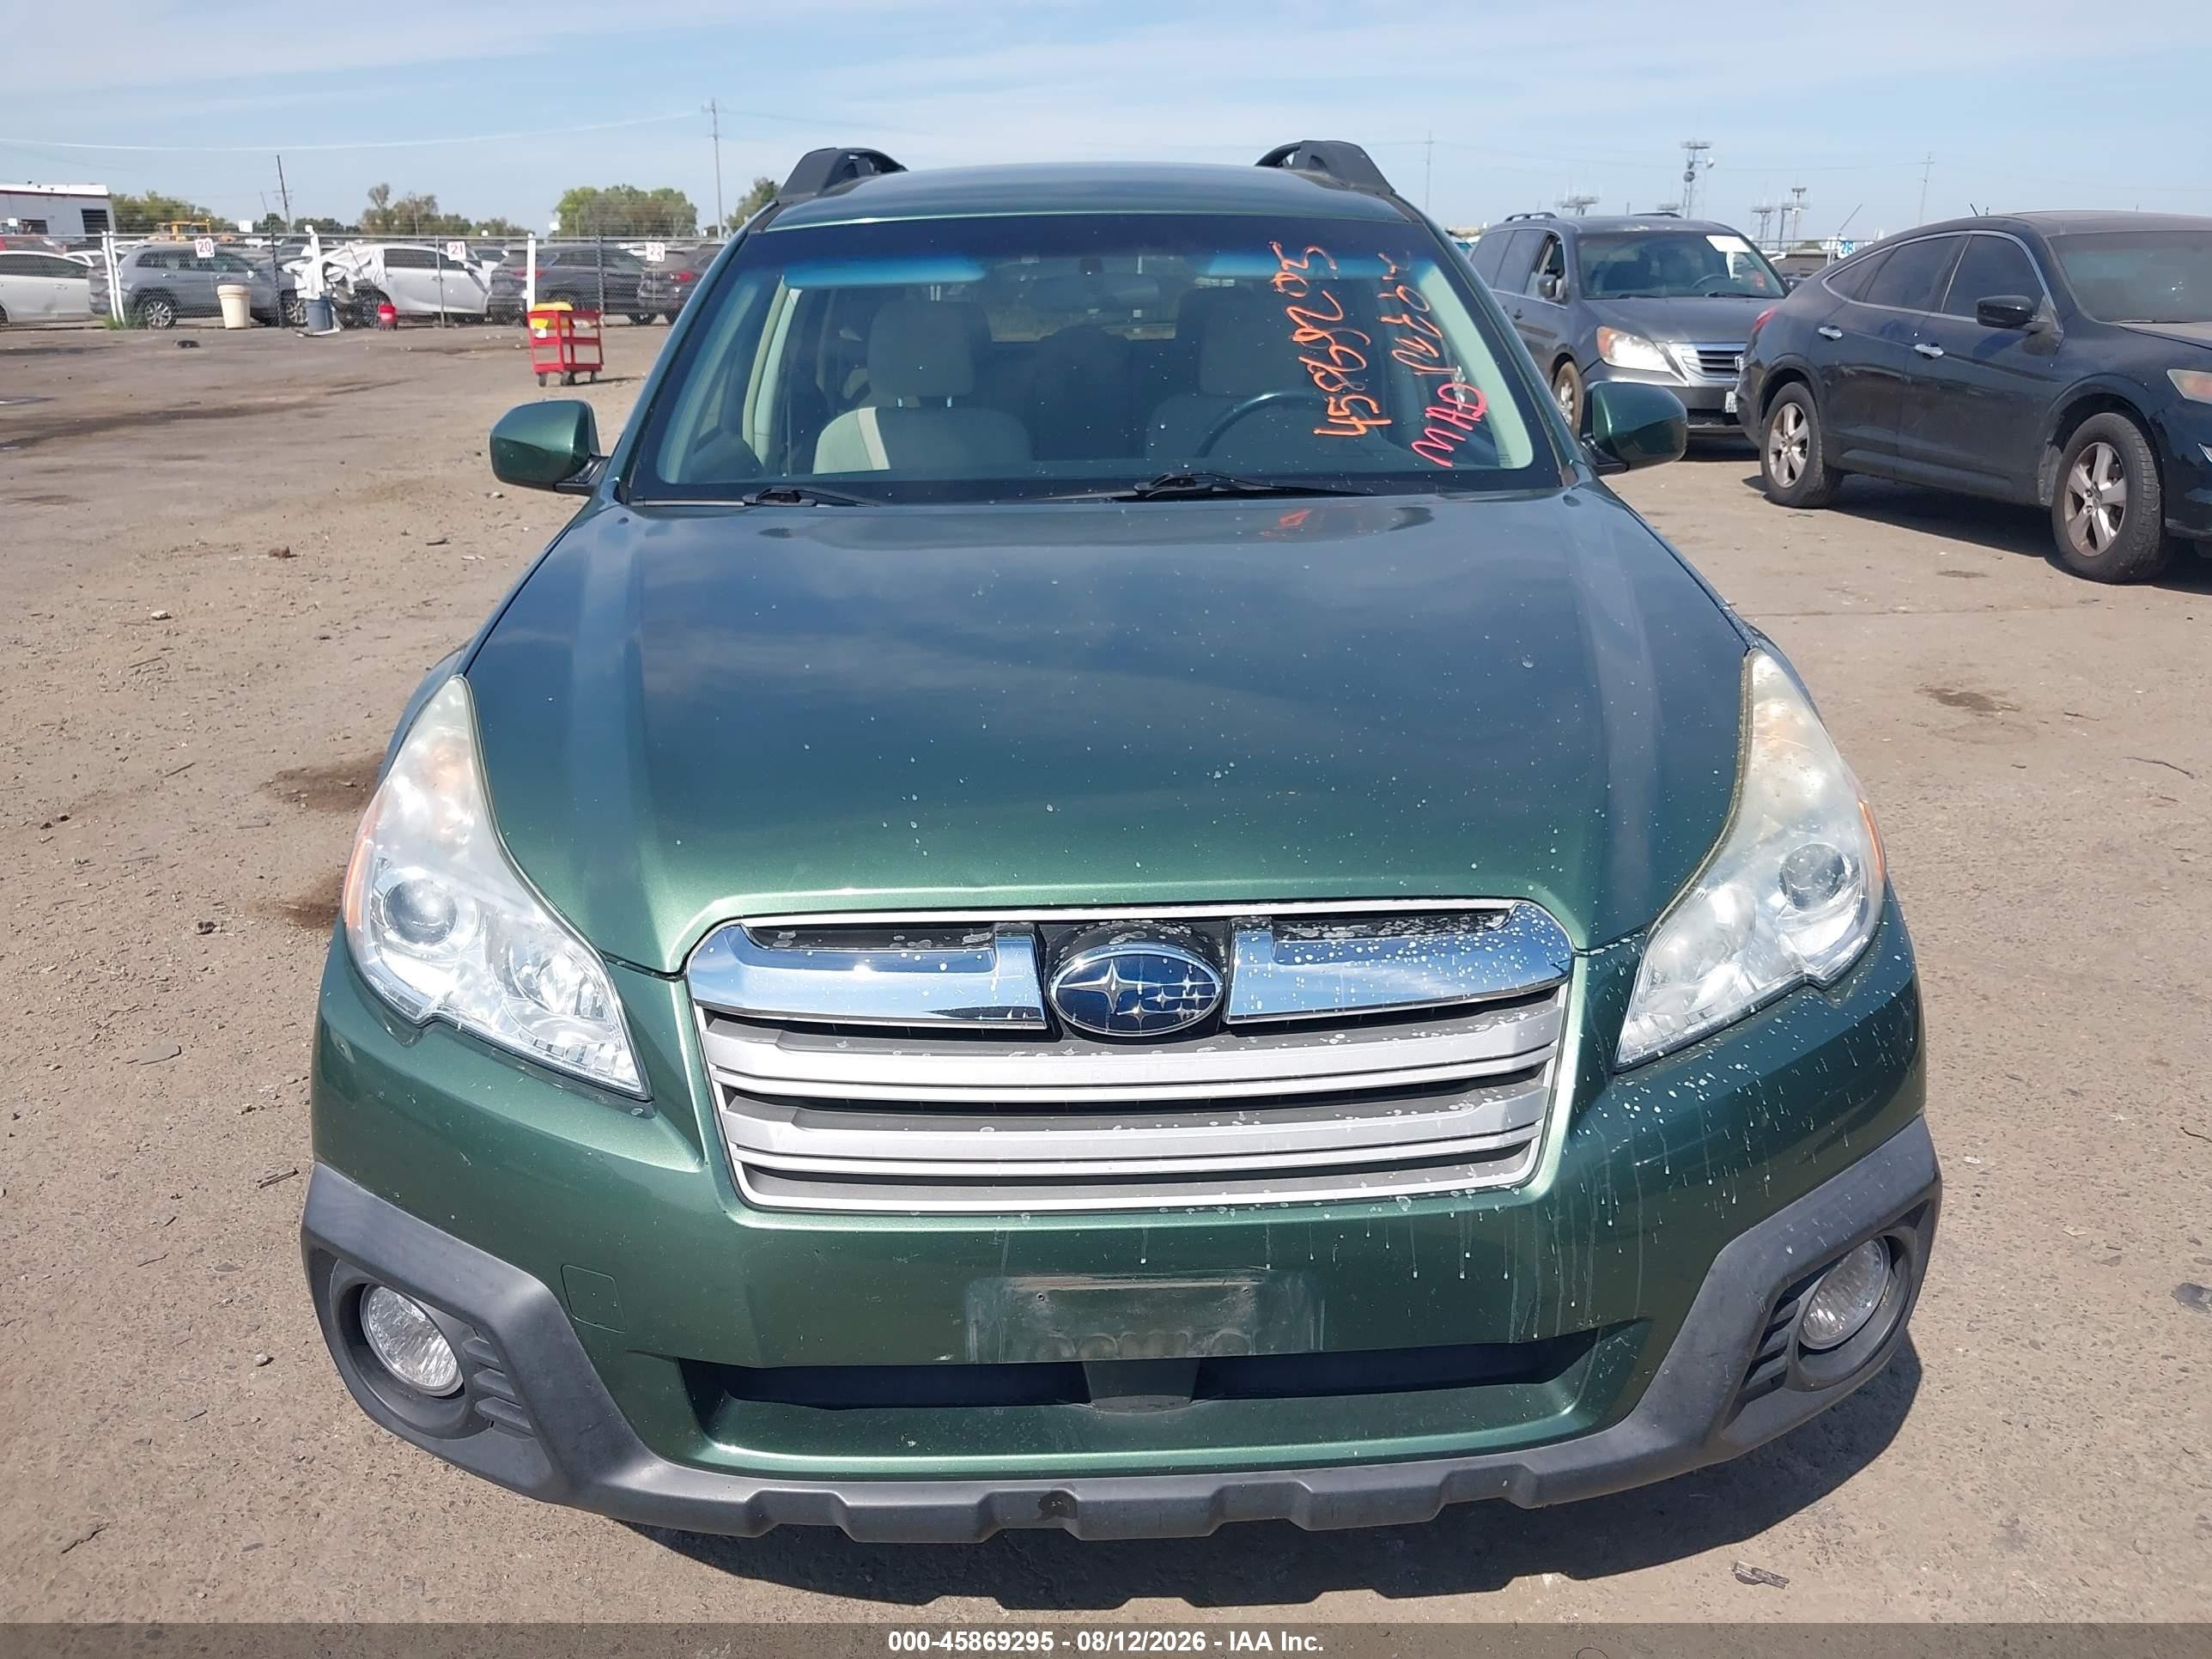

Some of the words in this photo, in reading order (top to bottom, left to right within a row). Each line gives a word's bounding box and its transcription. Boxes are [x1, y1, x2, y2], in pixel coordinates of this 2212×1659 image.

[198, 240, 212, 252] 20
[450, 244, 464, 255] 21
[1411, 383, 1489, 467] MAD
